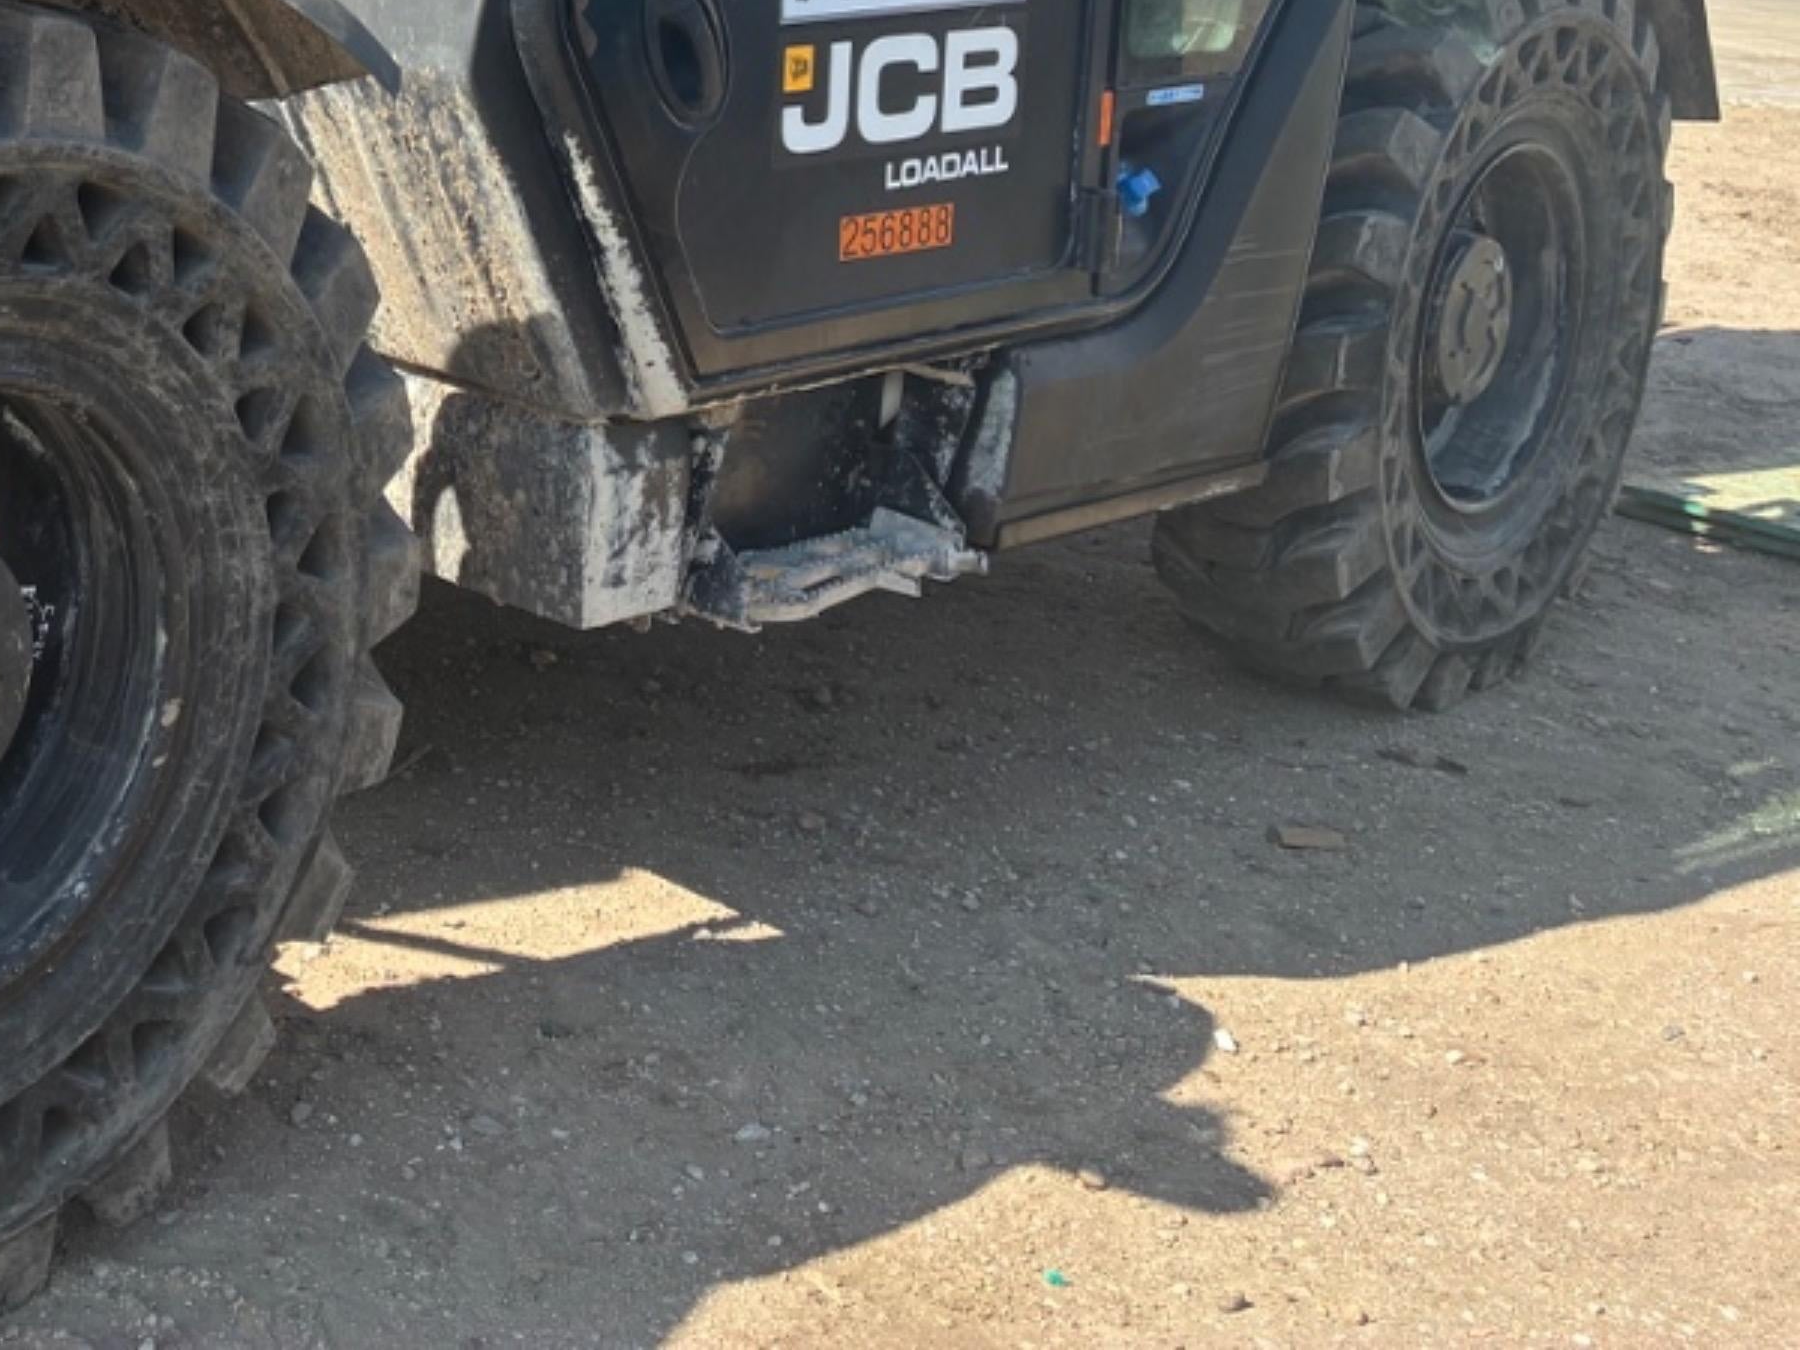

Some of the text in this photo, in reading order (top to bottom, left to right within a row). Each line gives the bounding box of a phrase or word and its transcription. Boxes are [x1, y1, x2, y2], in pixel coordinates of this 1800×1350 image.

[782, 26, 1019, 154] JCB
[884, 146, 1009, 190] LOADALL
[841, 205, 950, 258] 256888
